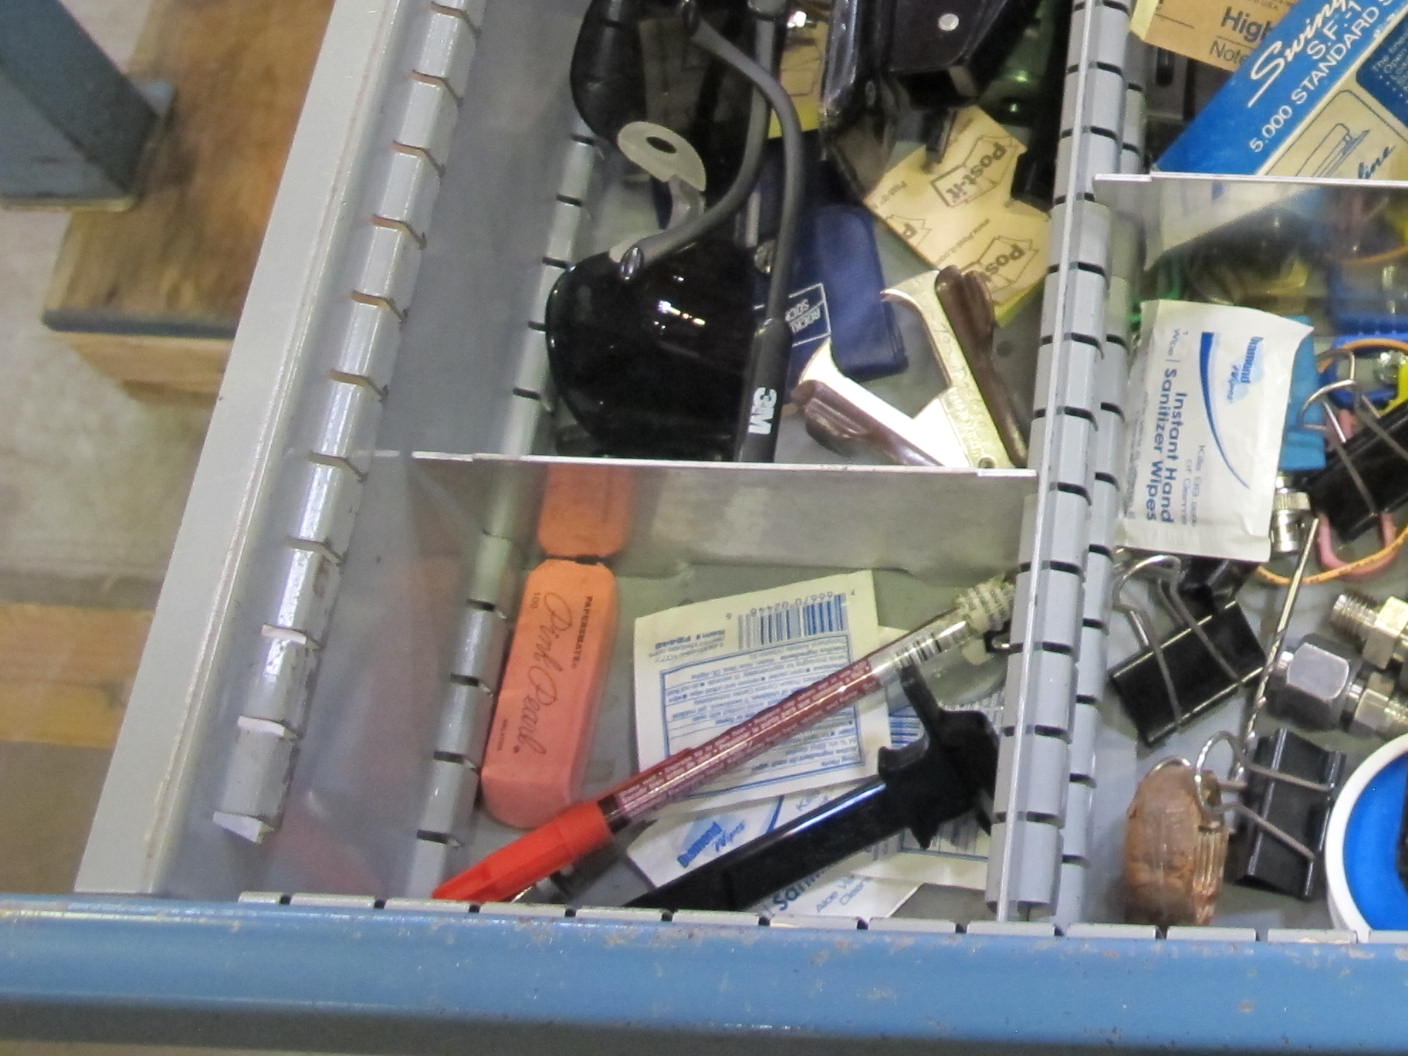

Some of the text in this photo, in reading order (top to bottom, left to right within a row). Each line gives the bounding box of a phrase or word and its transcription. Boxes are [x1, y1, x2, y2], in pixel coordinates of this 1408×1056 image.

[1292, 5, 1381, 106] STANDARD
[943, 141, 1012, 203] Post-it
[747, 385, 778, 434] 3M
[1142, 367, 1177, 521] Sanitizer Wipes
[1158, 391, 1188, 523] Instant Hand
[513, 591, 575, 756] Pink Pearl
